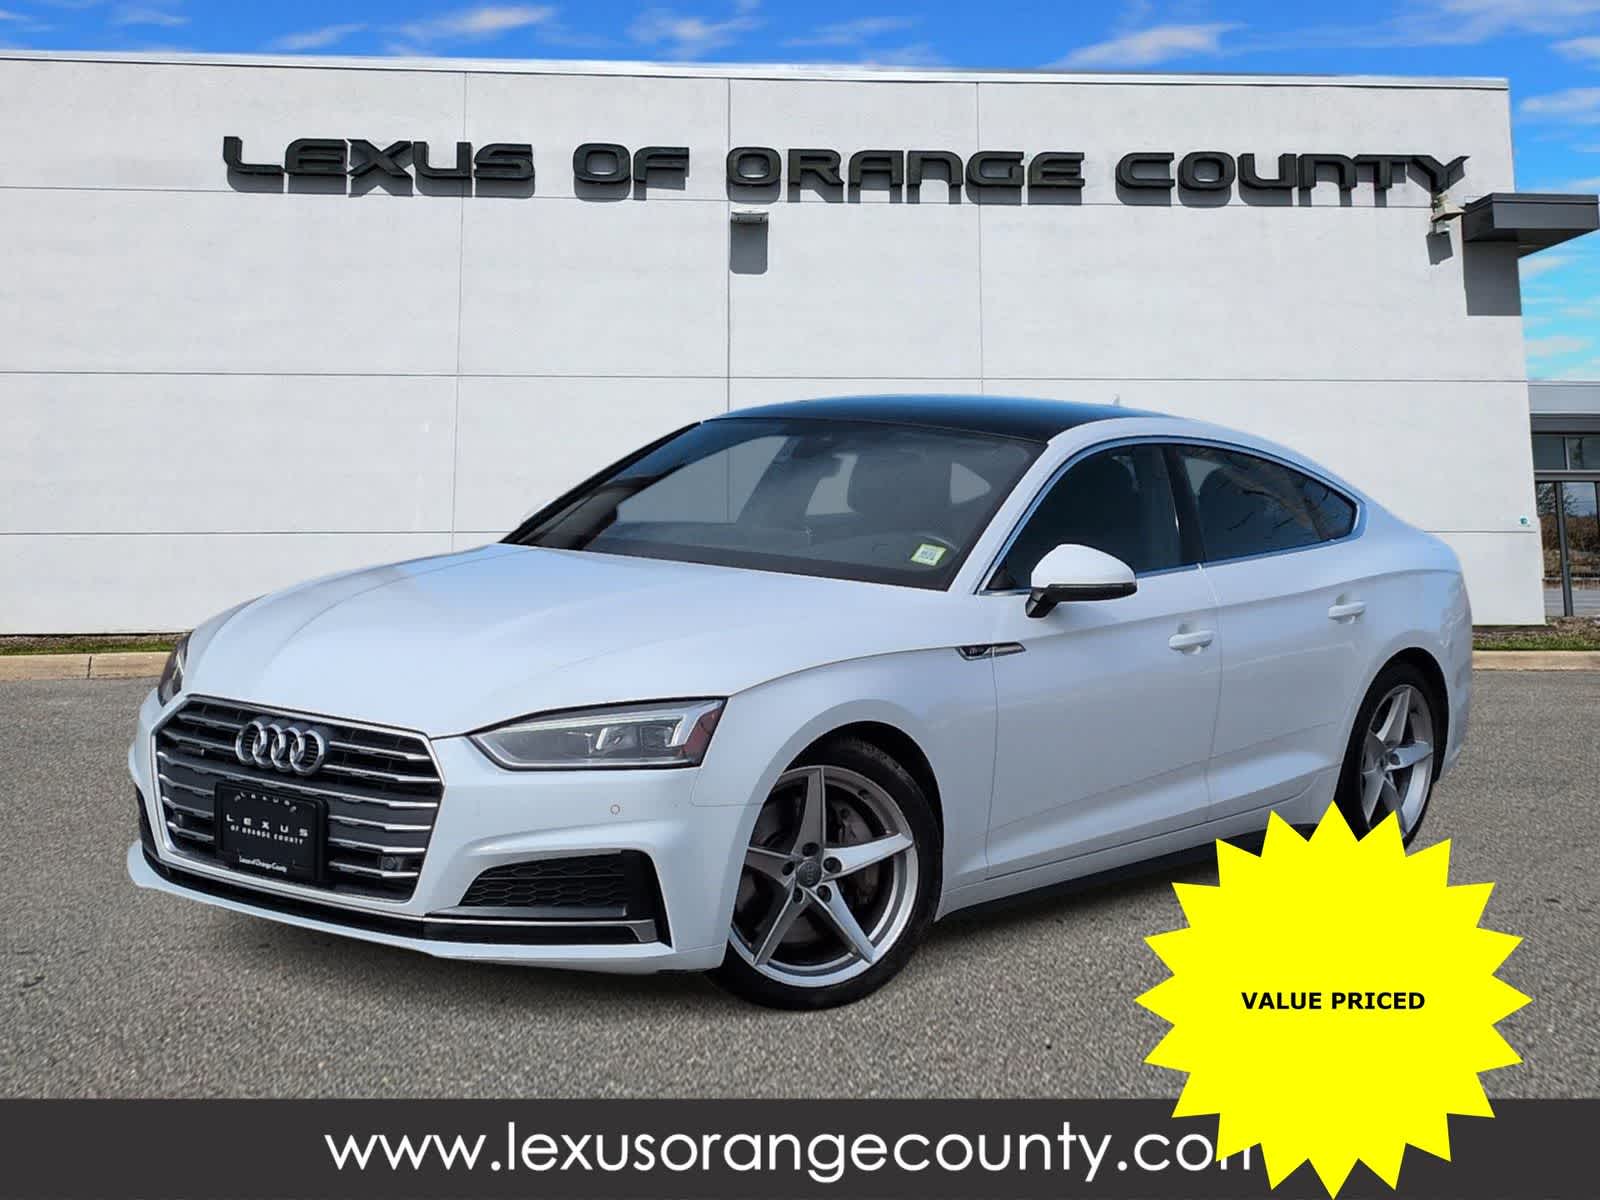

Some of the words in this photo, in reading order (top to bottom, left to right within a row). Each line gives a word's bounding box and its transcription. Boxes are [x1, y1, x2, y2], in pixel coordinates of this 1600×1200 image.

[223, 136, 534, 180] LEXUS
[573, 142, 690, 184] OF
[727, 146, 1085, 187] ORANGE
[1115, 151, 1469, 191] COUNTY
[226, 814, 308, 837] LEXUS
